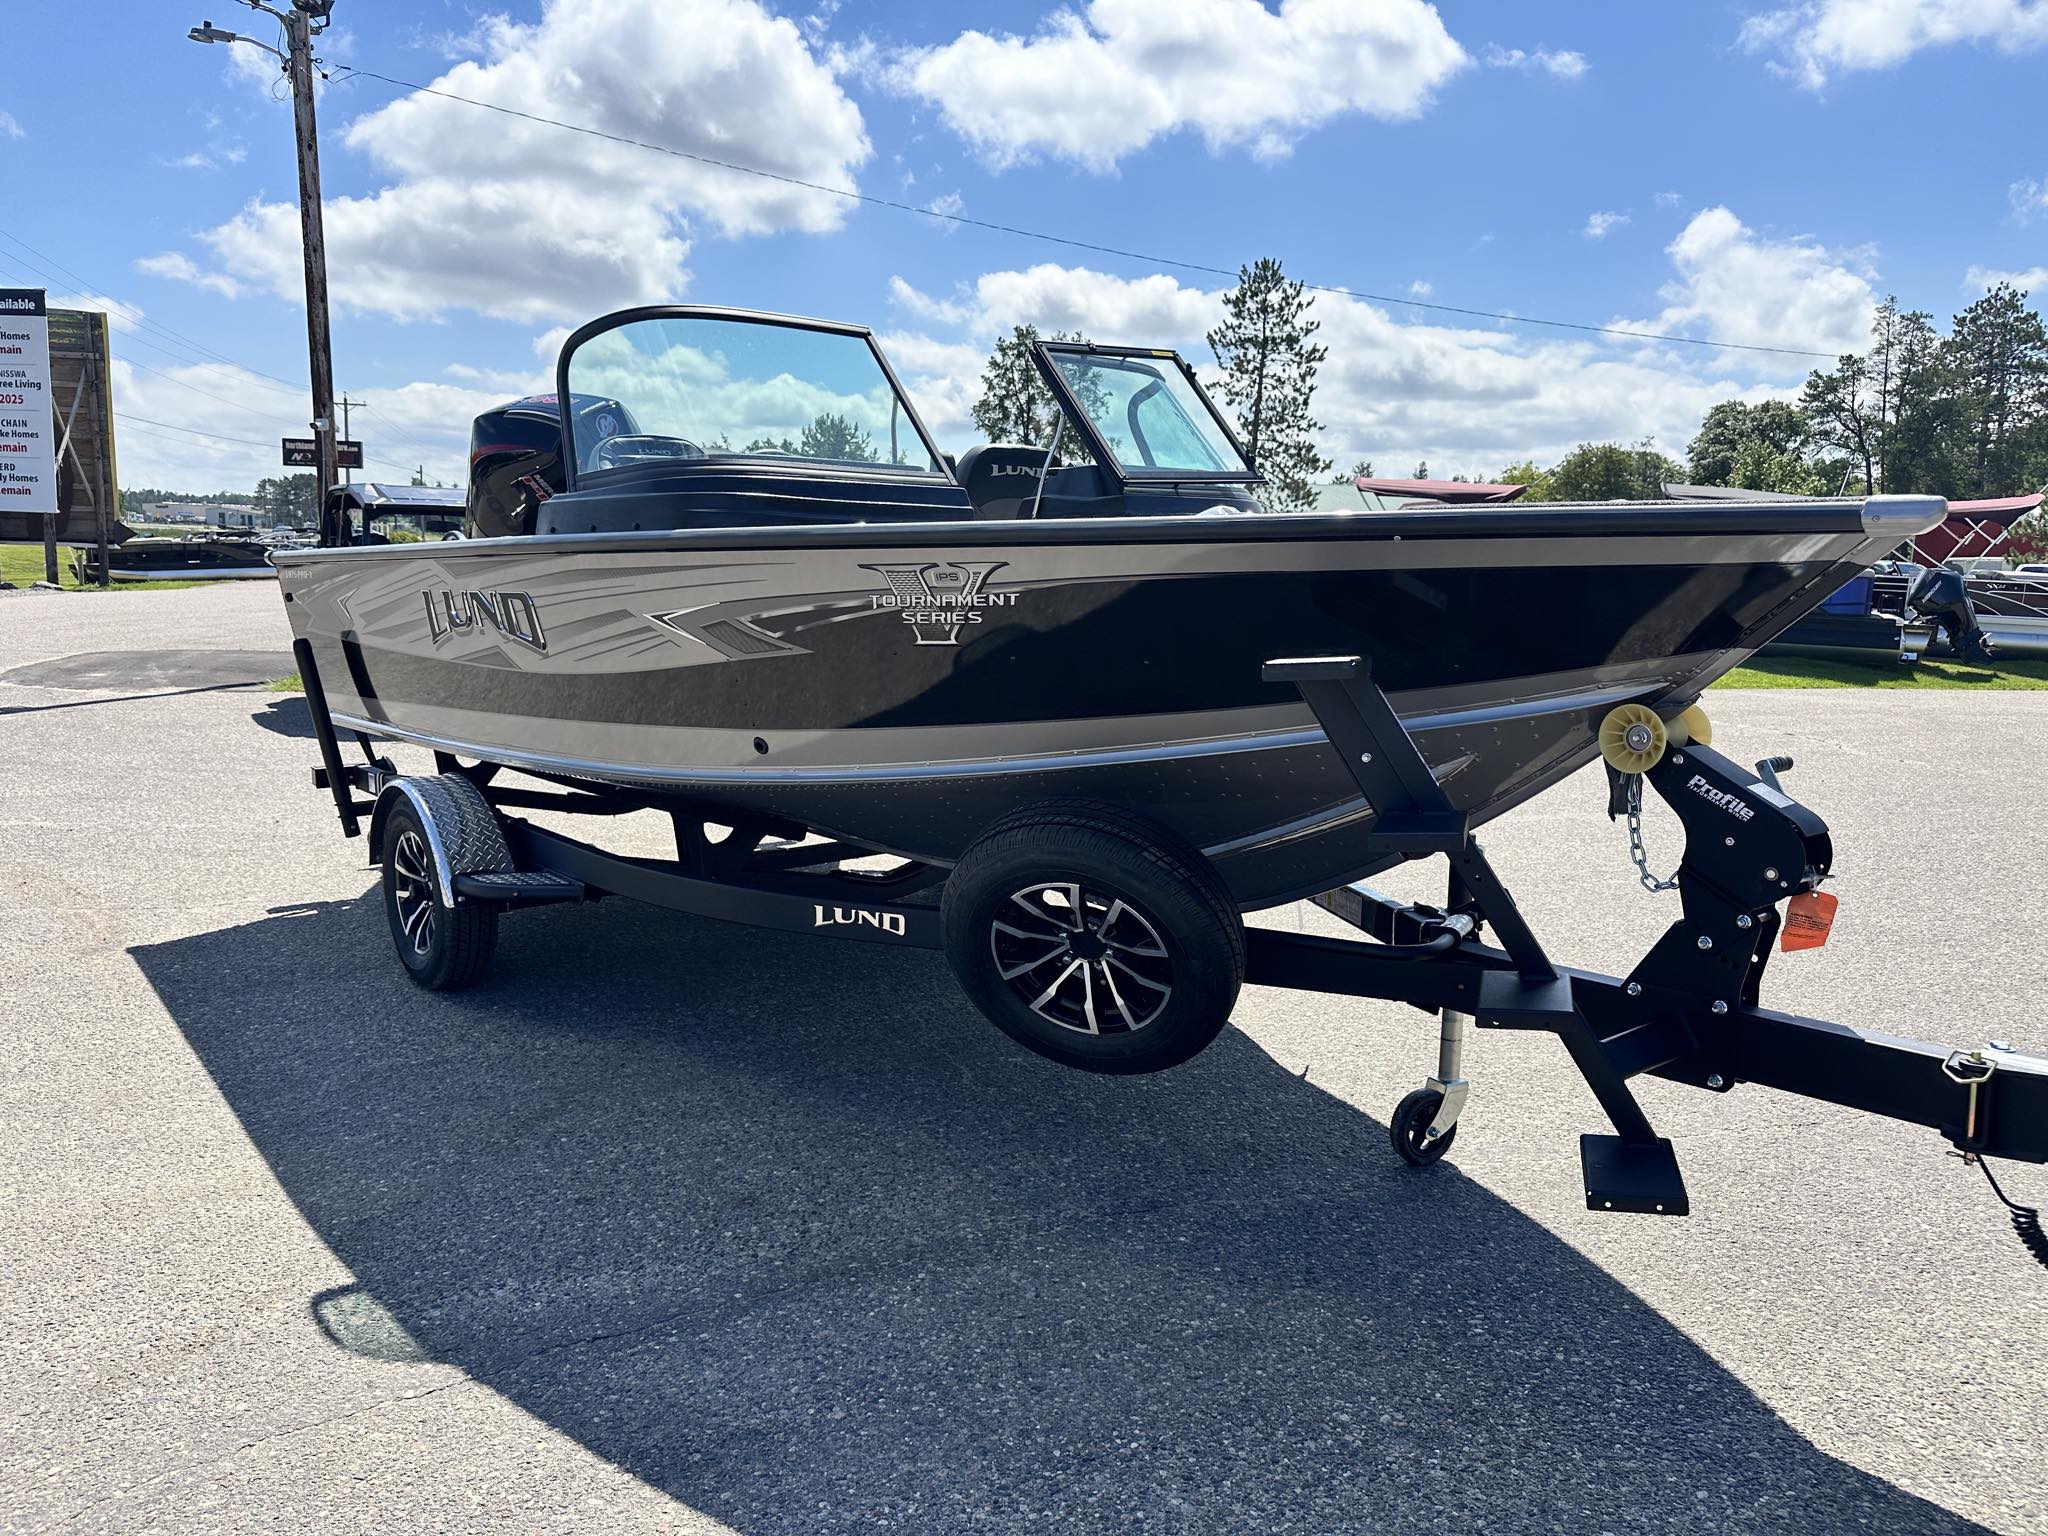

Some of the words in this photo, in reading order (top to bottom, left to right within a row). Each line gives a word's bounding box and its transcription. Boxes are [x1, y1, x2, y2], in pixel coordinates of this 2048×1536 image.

[1, 331, 30, 340] Homes
[15, 379, 41, 390] Living
[1, 419, 27, 428] CHAIN
[11, 430, 39, 439] Homes
[9, 474, 39, 483] Homes
[936, 573, 959, 582] IPS
[869, 593, 1020, 609] TOURNAMENT
[421, 589, 547, 650] LUND
[901, 611, 983, 624] SERIES
[1686, 783, 1727, 809] PERFORMANCE
[1689, 774, 1755, 819] Profile
[814, 904, 905, 936] LUND
